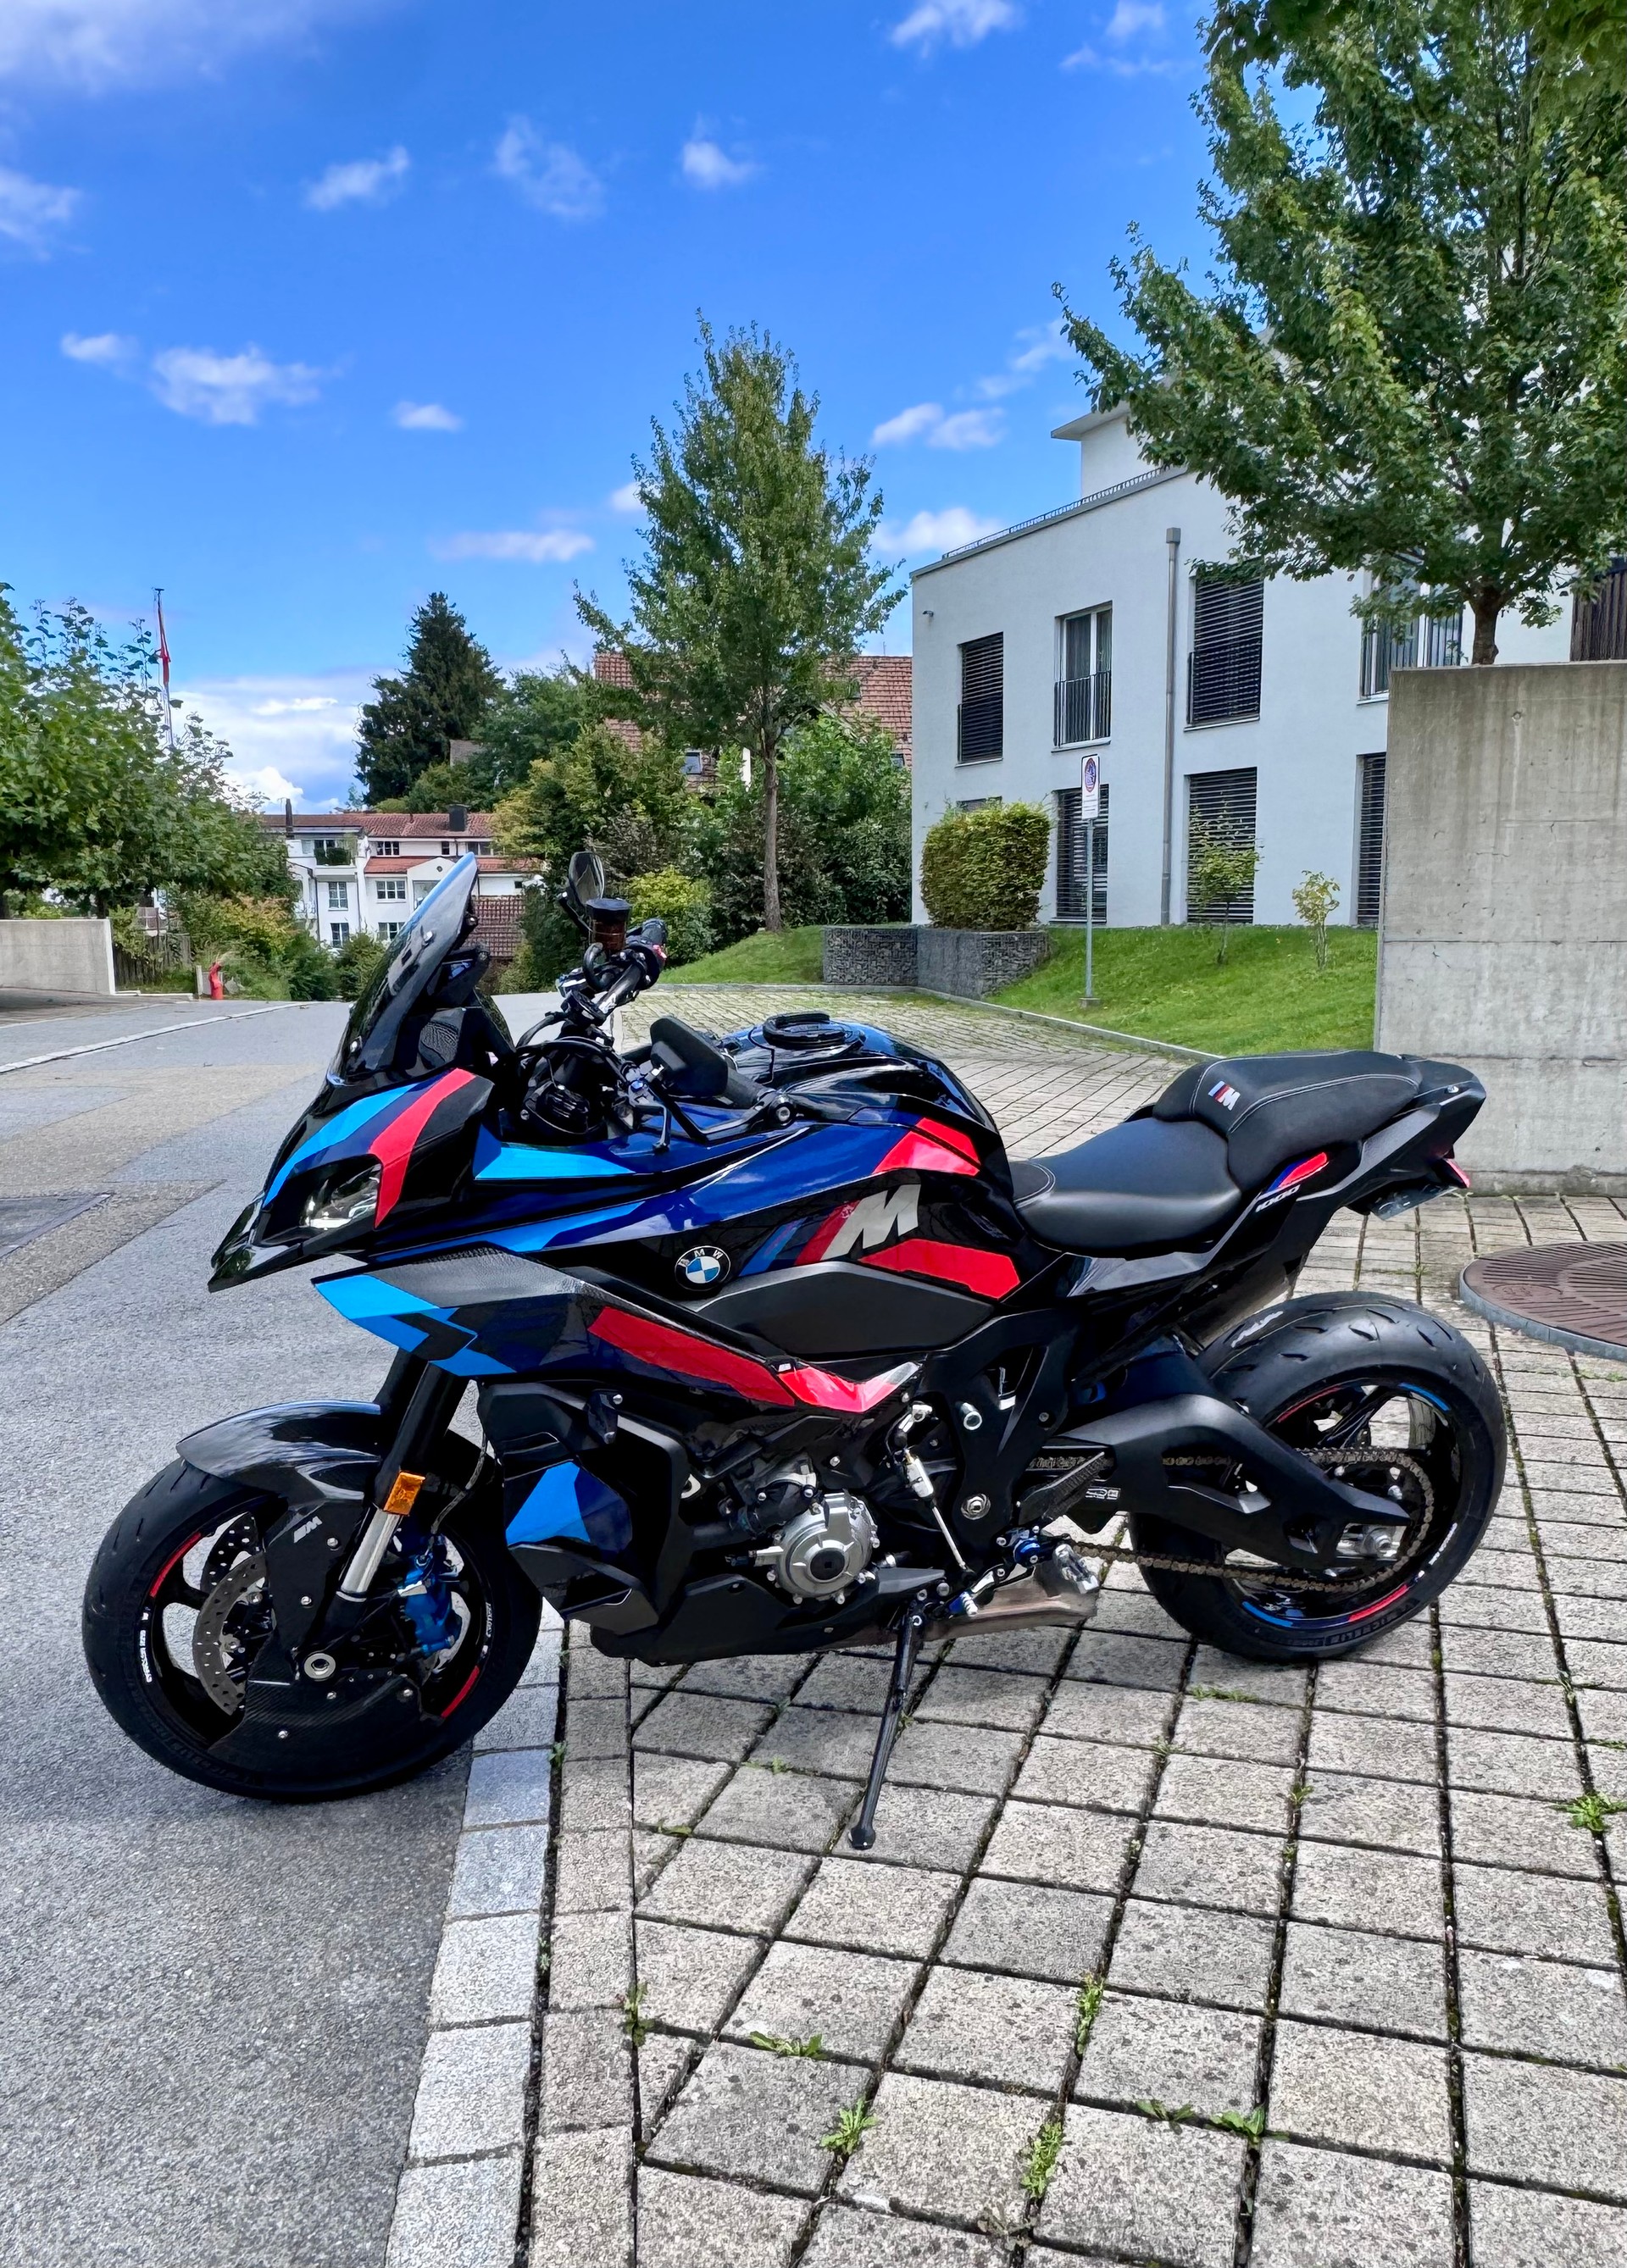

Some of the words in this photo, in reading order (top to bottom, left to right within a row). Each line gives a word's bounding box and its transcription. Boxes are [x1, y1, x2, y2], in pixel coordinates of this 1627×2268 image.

[1218, 1086, 1241, 1111] M
[1255, 1184, 1301, 1212] 1000
[819, 1184, 921, 1261] M
[678, 1249, 723, 1267] BMW
